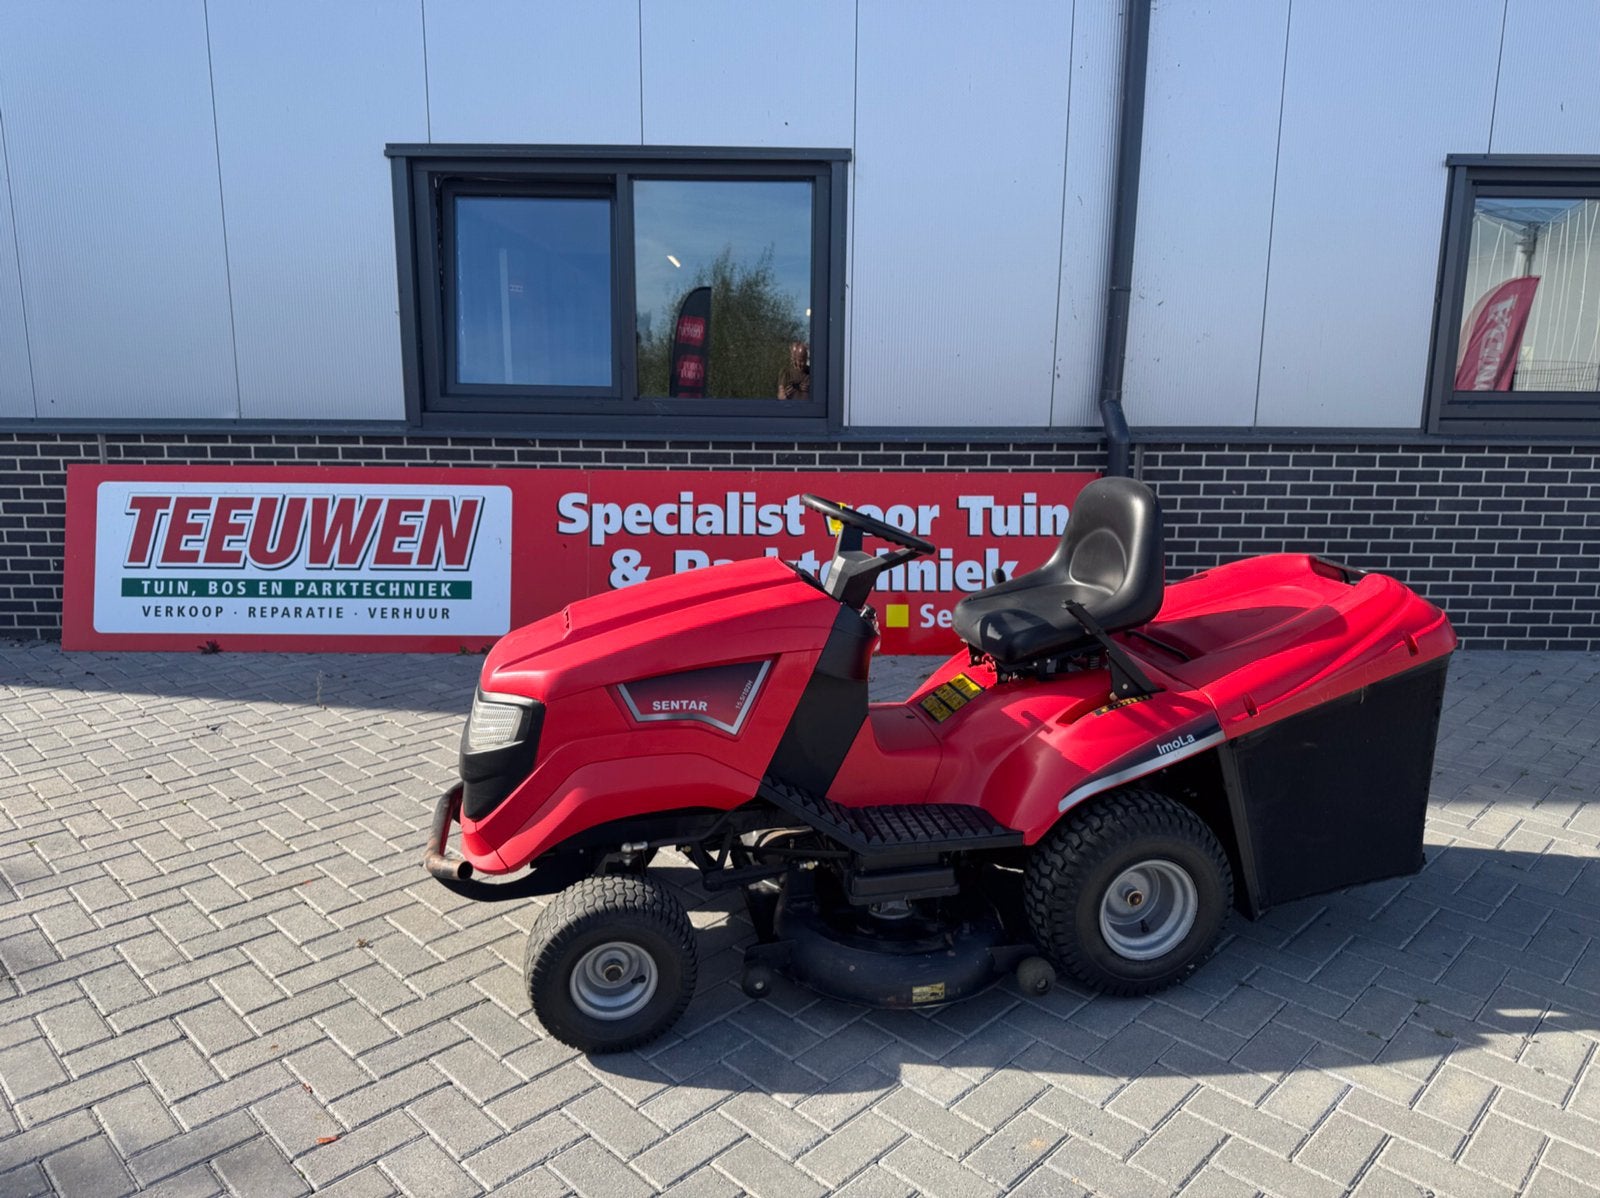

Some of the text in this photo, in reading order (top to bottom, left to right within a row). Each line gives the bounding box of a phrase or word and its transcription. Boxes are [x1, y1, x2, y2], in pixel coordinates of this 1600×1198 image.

[123, 492, 485, 571] TEEUWEN
[557, 491, 806, 546] Specialist
[957, 492, 1070, 537] Tuin
[609, 548, 651, 590] &
[141, 580, 452, 597] TUIN, BOS EN PARKTECHNIEK
[142, 605, 450, 620] VERKOOP REPARATIE VERHUUR
[652, 700, 708, 712] SENTAR
